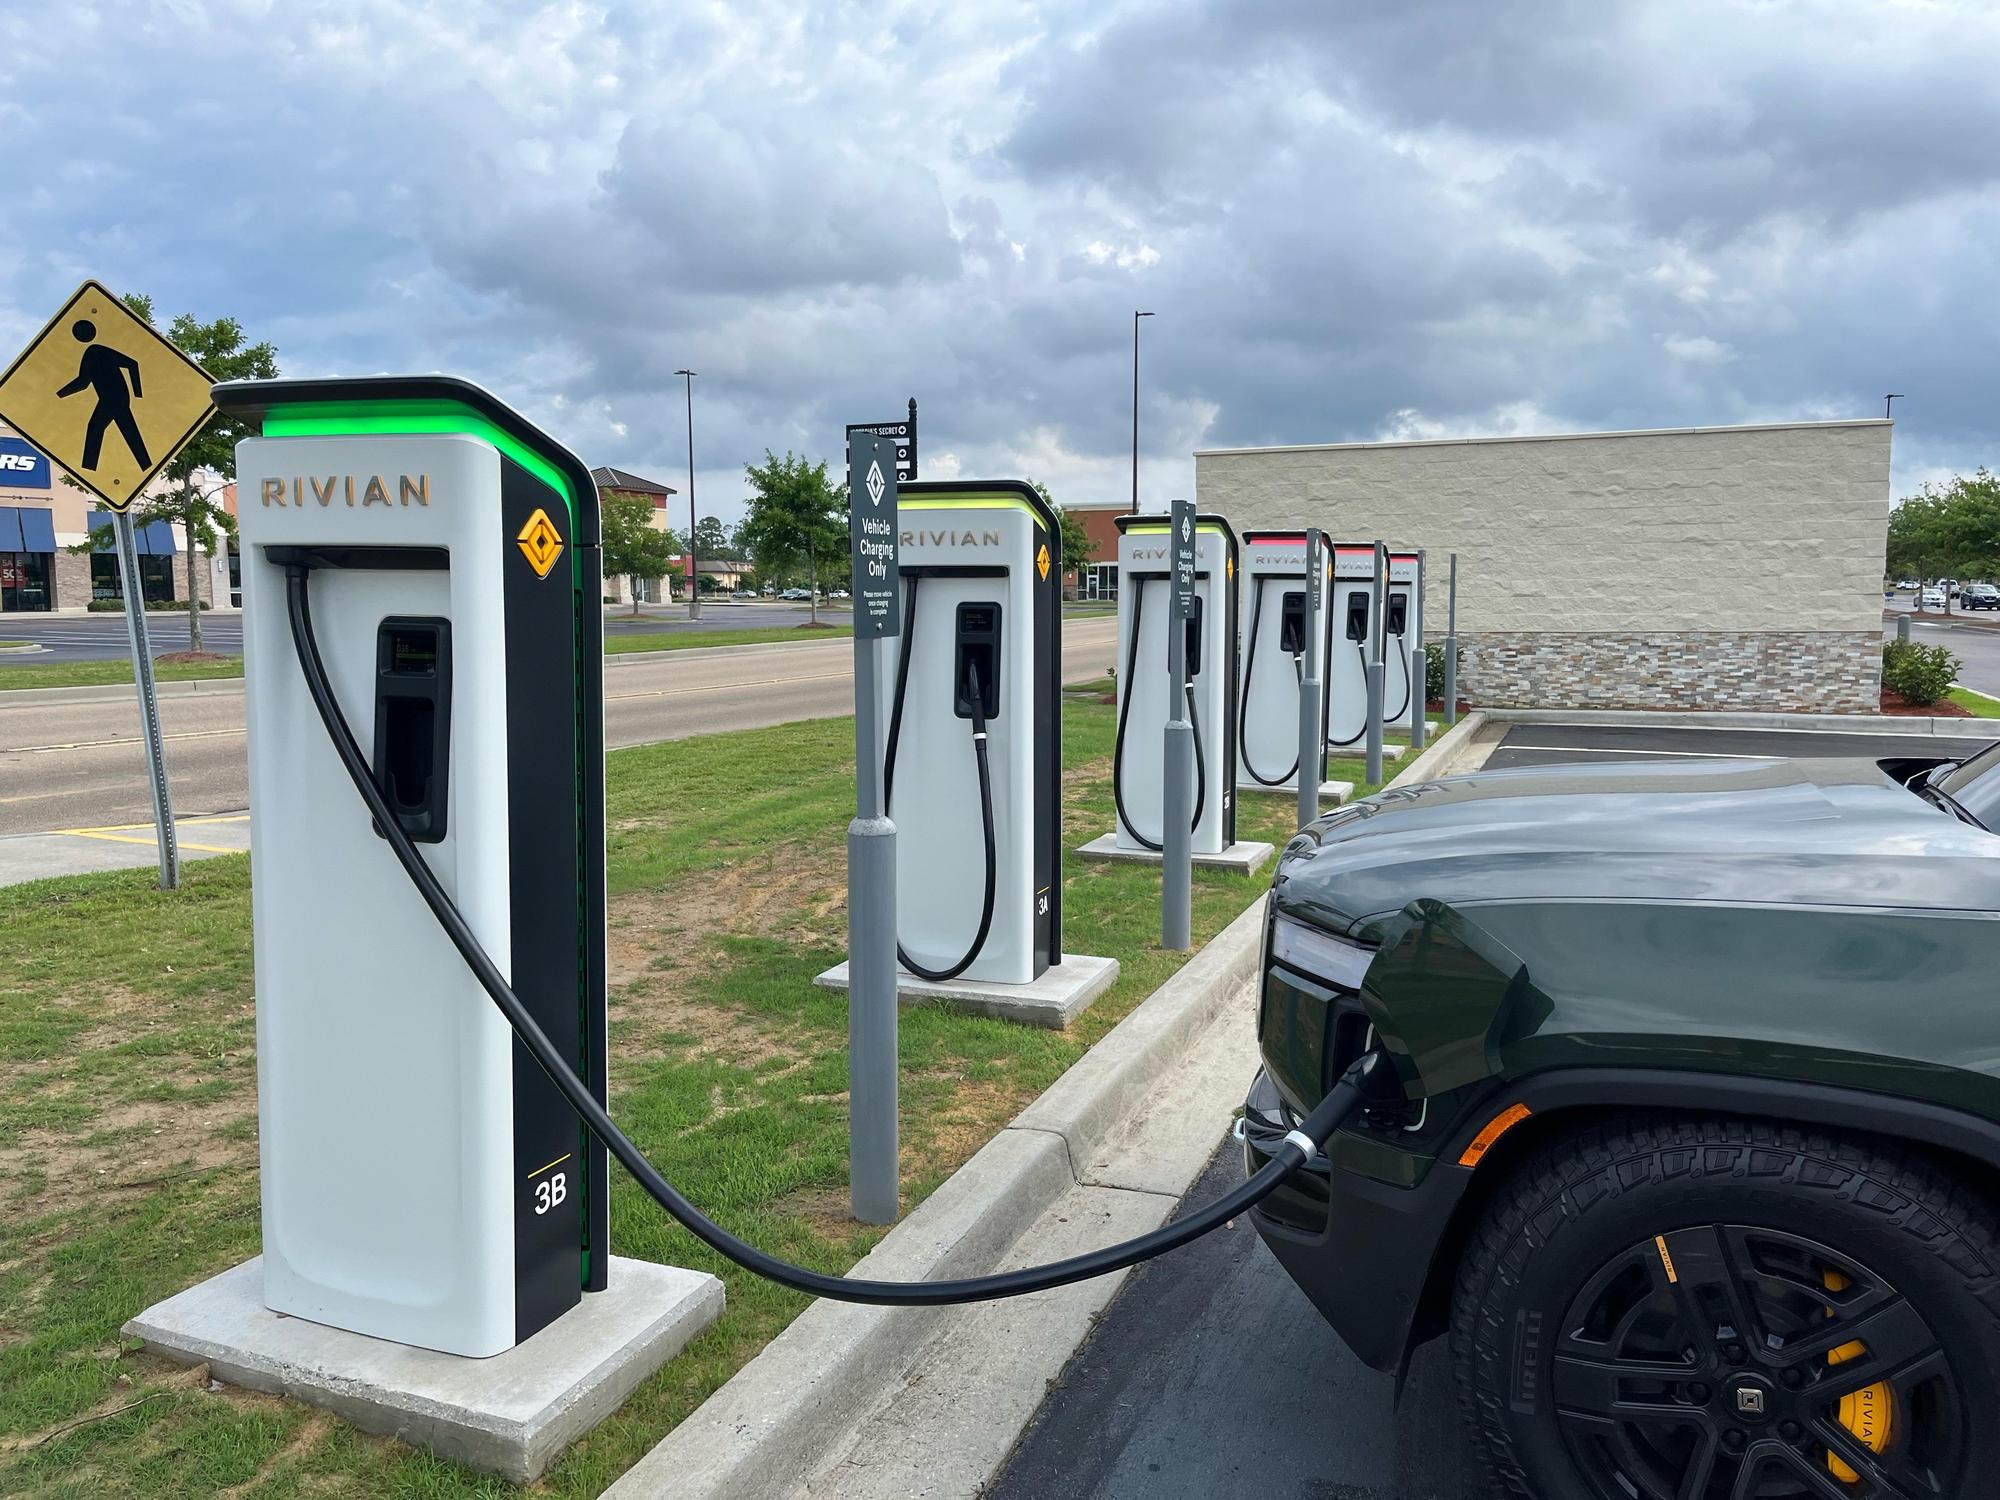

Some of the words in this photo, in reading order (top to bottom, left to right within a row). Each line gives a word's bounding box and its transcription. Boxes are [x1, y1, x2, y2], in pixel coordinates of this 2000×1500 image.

[879, 426, 898, 436] SECRET
[0, 454, 37, 472] RS
[261, 474, 430, 507] RIVIAN
[861, 517, 891, 536] Vehicle
[899, 530, 1000, 547] RIVIAN
[859, 539, 894, 560] Charging
[1132, 549, 1205, 560] RIVN
[868, 560, 887, 581] Only
[1038, 895, 1049, 916] 3A
[534, 1172, 567, 1215] 3B
[1660, 1246, 1673, 1273] RIVIAN
[1510, 1308, 1544, 1415] PIRELLI
